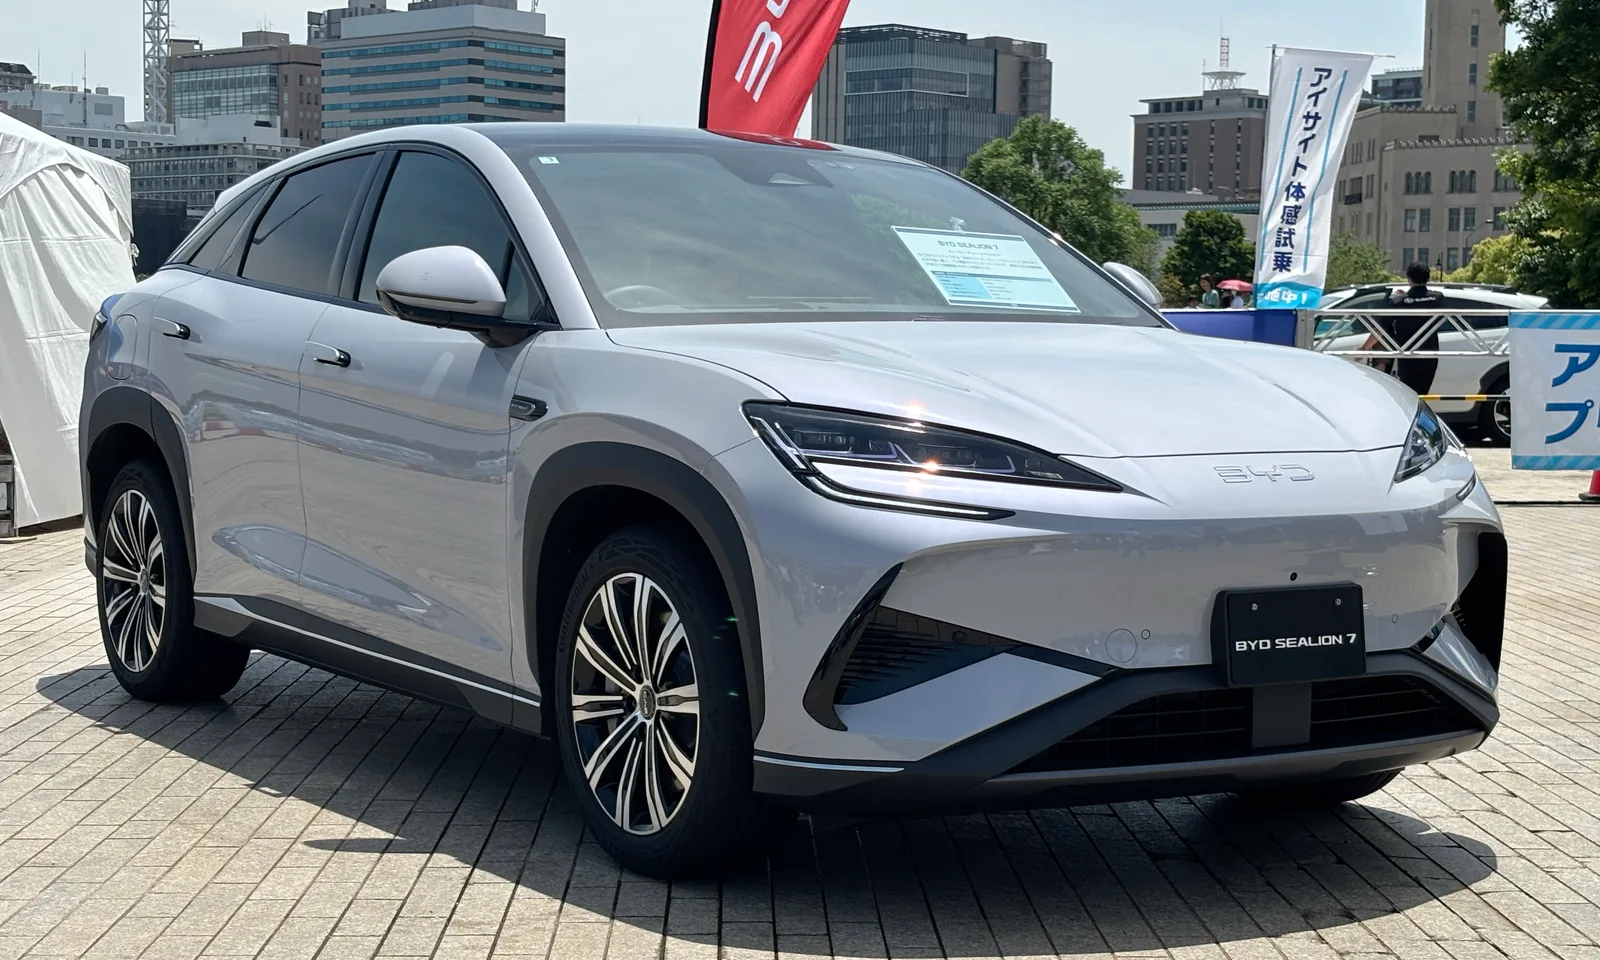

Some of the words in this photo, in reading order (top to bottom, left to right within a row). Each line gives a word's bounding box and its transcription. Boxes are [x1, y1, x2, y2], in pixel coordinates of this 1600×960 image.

[1272, 67, 1332, 273] アイサイト体感試乗
[957, 242, 993, 250] SEALION
[1213, 464, 1316, 484] BYD
[1235, 639, 1271, 652] BYD
[1275, 634, 1343, 649] SEALION
[1346, 633, 1357, 644] 7
